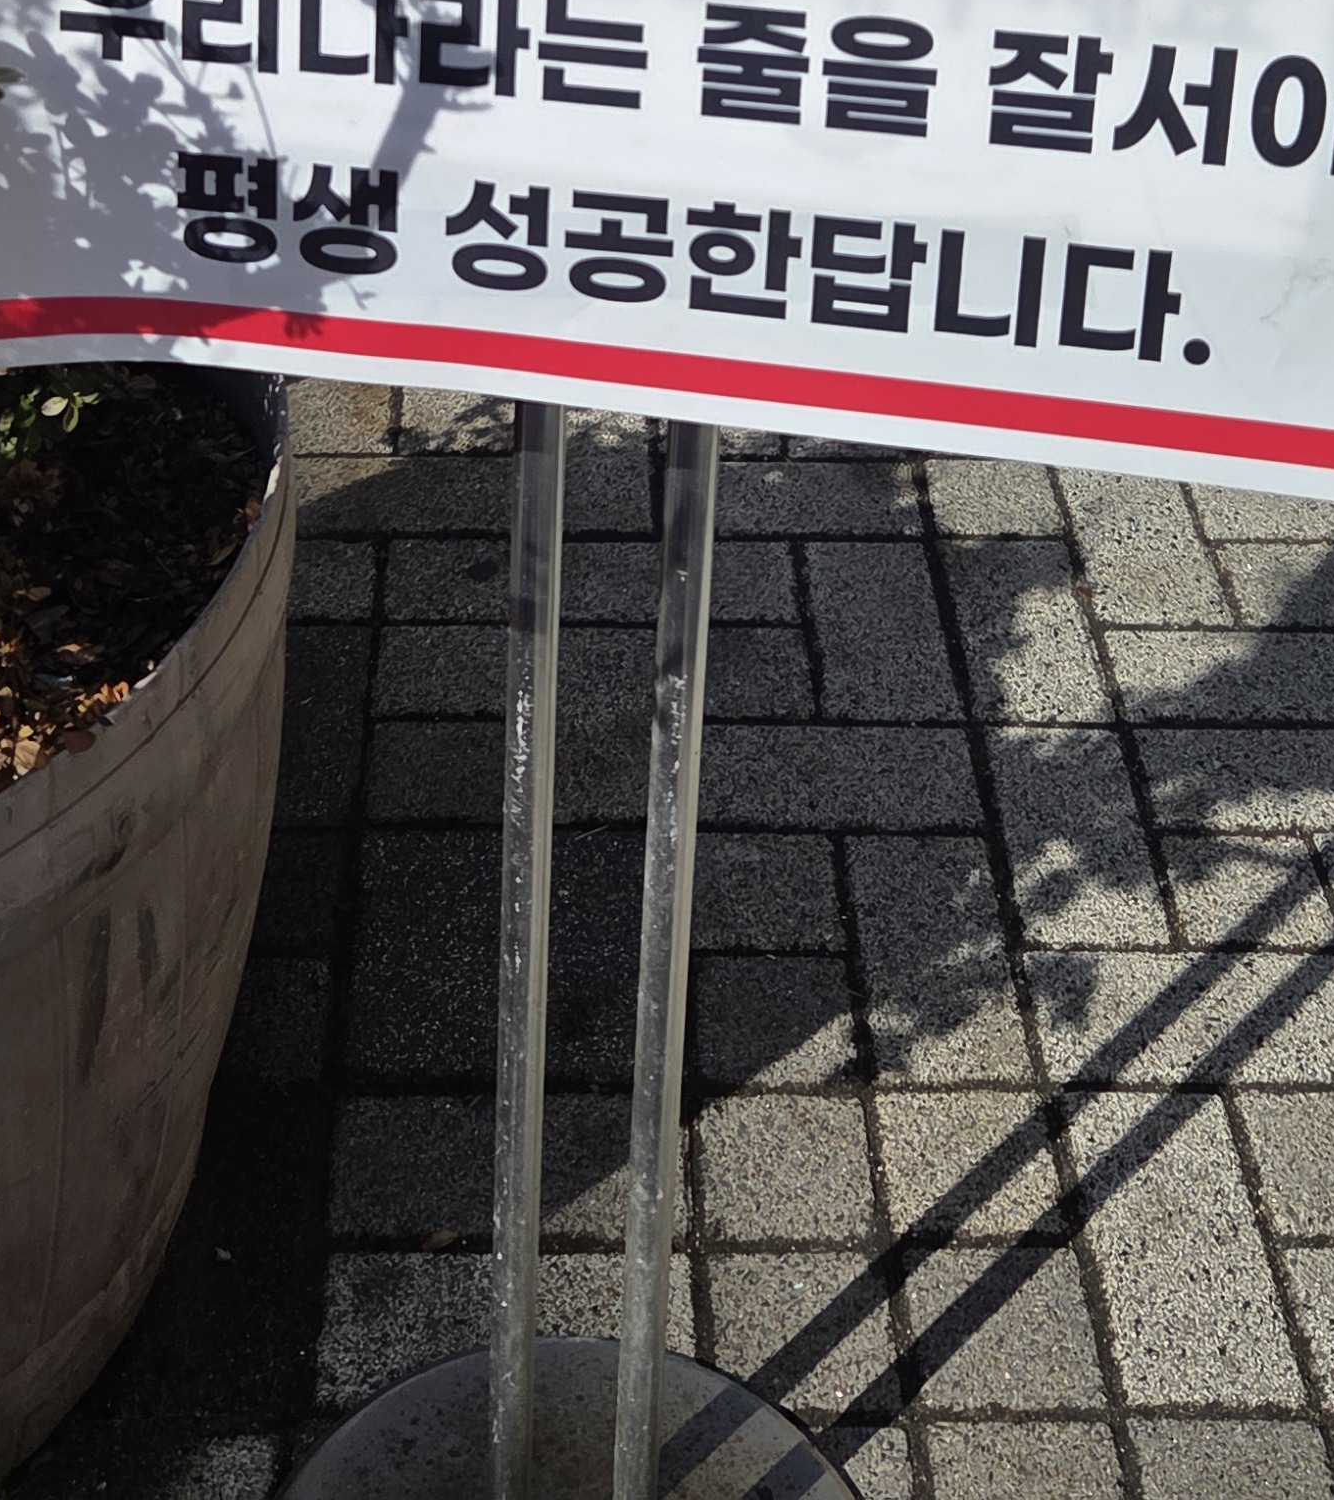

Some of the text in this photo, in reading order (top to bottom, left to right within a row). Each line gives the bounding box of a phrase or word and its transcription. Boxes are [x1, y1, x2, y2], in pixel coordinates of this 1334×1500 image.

[696, 1, 938, 140] 줄을
[175, 151, 1212, 365] 평생 성공한답니다.
